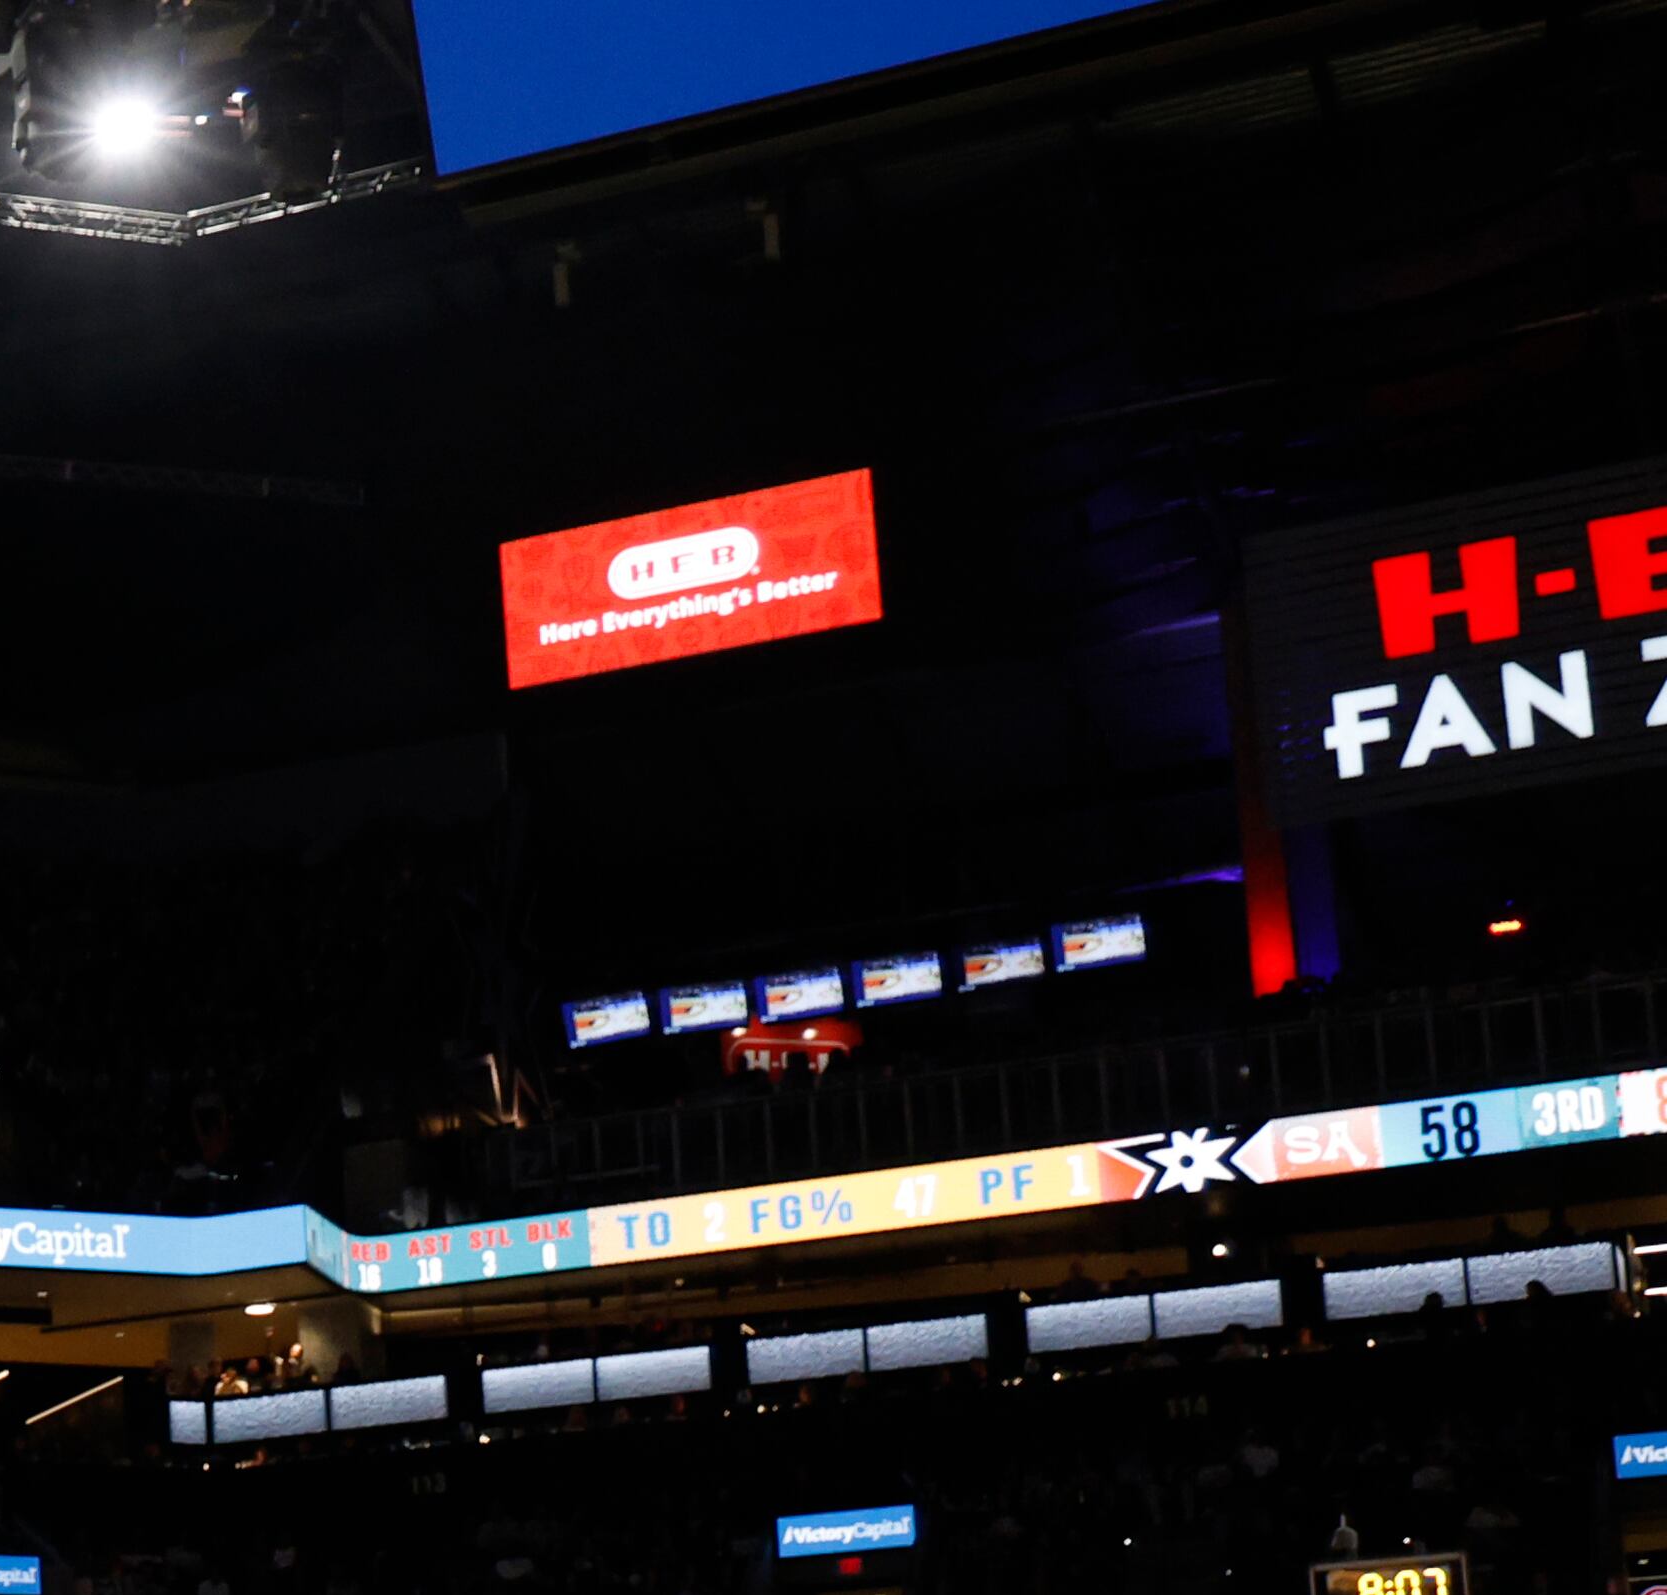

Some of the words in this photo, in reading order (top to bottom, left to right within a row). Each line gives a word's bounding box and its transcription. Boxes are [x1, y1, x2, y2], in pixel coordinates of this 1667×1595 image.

[539, 616, 599, 645] Here
[602, 587, 754, 628] Everything's
[757, 571, 839, 603] Better
[1324, 649, 1595, 779] FAN
[1283, 1120, 1367, 1167] SA
[1421, 1100, 1481, 1160] 58
[1532, 1086, 1606, 1137] 3RD
[408, 1234, 452, 1257] AST
[469, 1226, 512, 1250] STL
[527, 1219, 572, 1242] BLK
[618, 1211, 671, 1250] TO
[703, 1202, 726, 1243] 2
[750, 1188, 854, 1234] FG%
[894, 1174, 939, 1219] 47
[979, 1165, 1034, 1206] PF
[1067, 1154, 1092, 1198] 1
